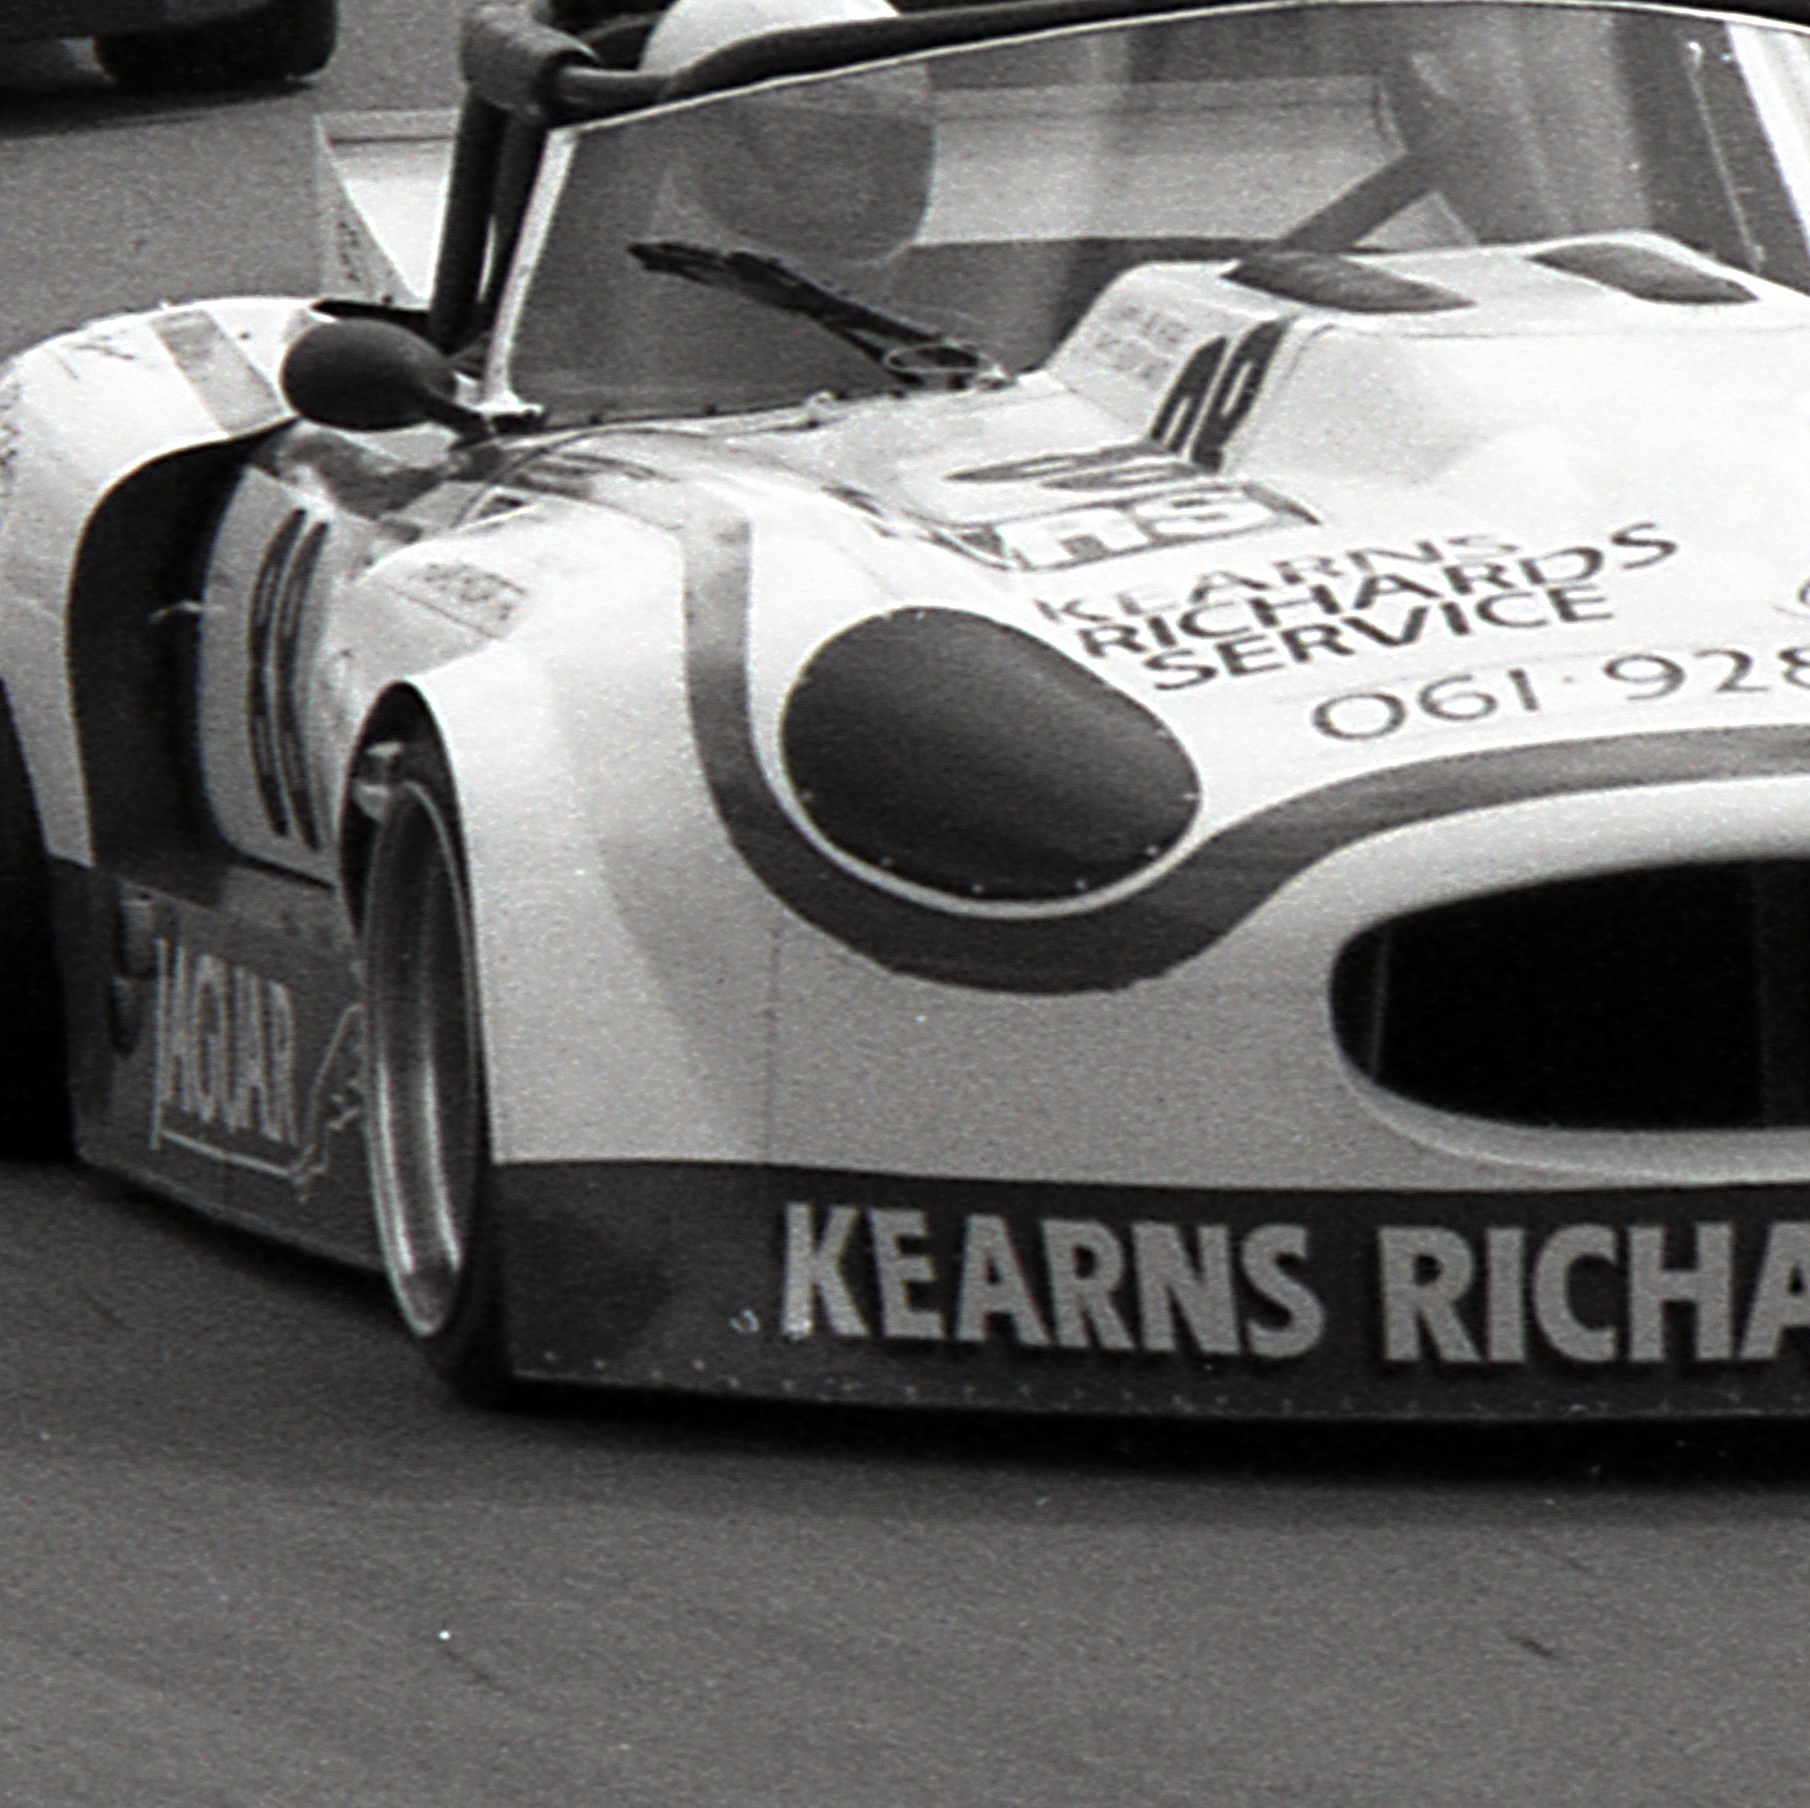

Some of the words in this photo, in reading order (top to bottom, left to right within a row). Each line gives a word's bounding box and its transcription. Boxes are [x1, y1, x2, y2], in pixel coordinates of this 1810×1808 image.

[1033, 532, 1521, 624] KEARNS
[1073, 521, 1679, 658] RICHARDS
[1141, 582, 1615, 691] SERVICE
[781, 1201, 1326, 1360] KEARNS
